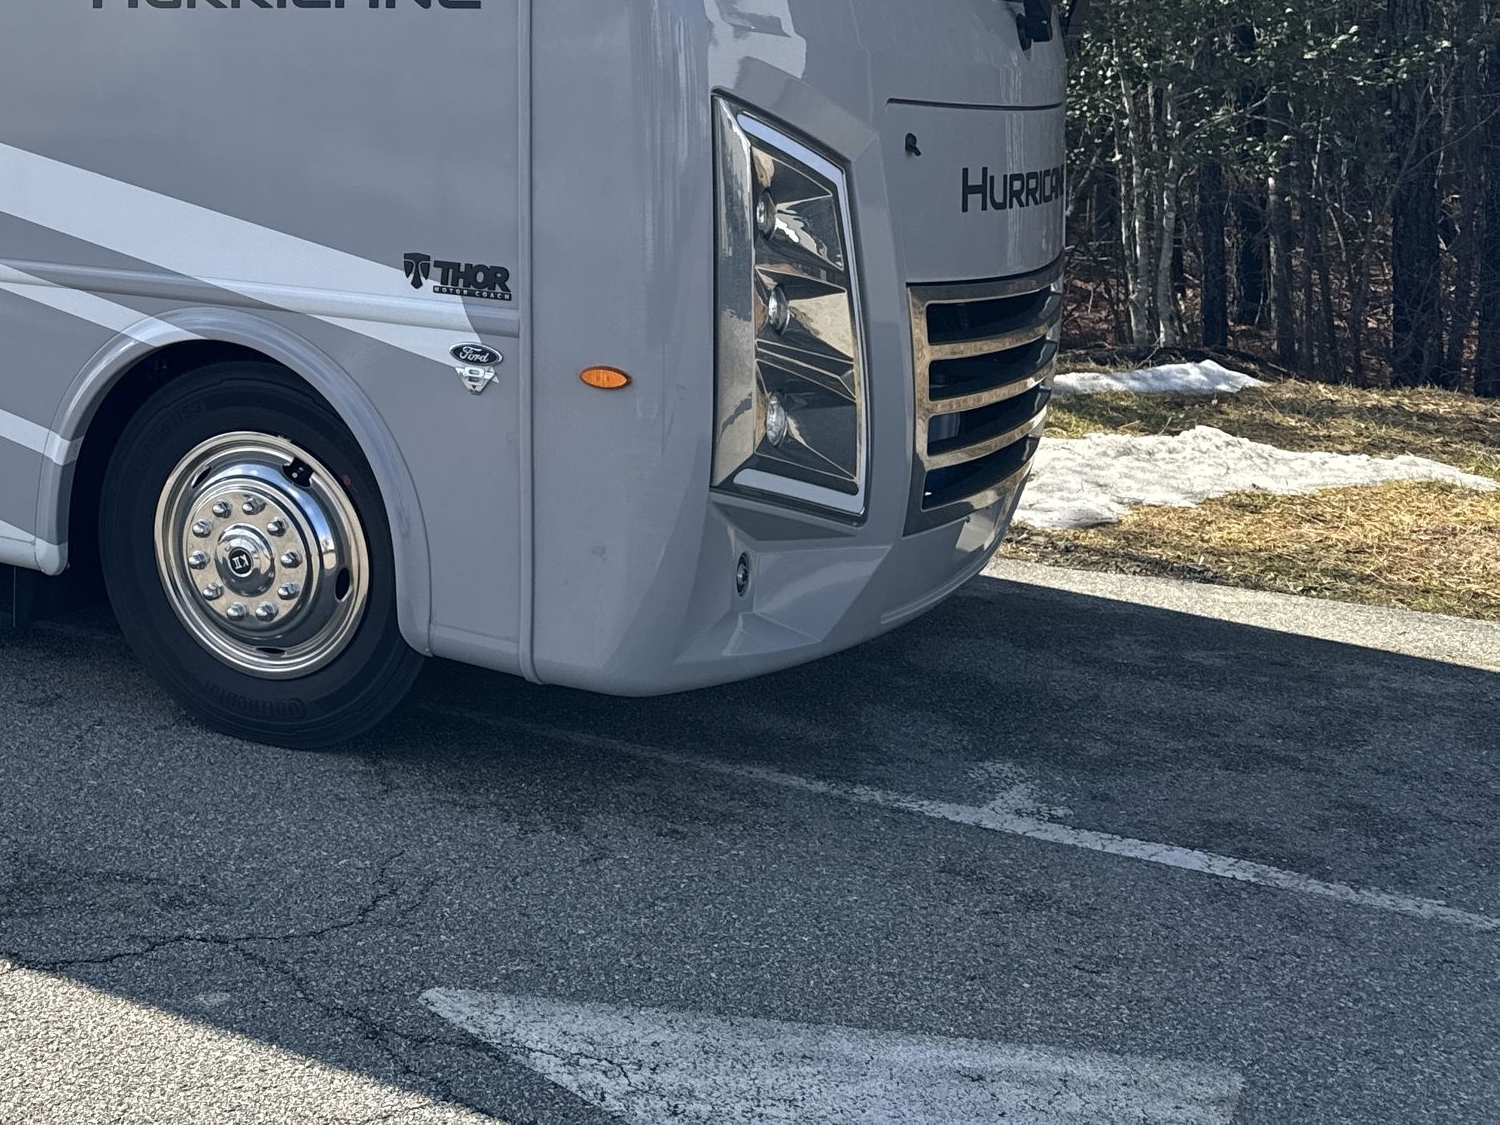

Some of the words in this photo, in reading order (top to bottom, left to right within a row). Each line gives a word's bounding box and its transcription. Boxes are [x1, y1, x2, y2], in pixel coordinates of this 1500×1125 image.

[433, 260, 511, 292] THOR
[434, 287, 468, 295] MOTOR
[475, 291, 510, 299] COACH
[459, 346, 490, 362] Ford
